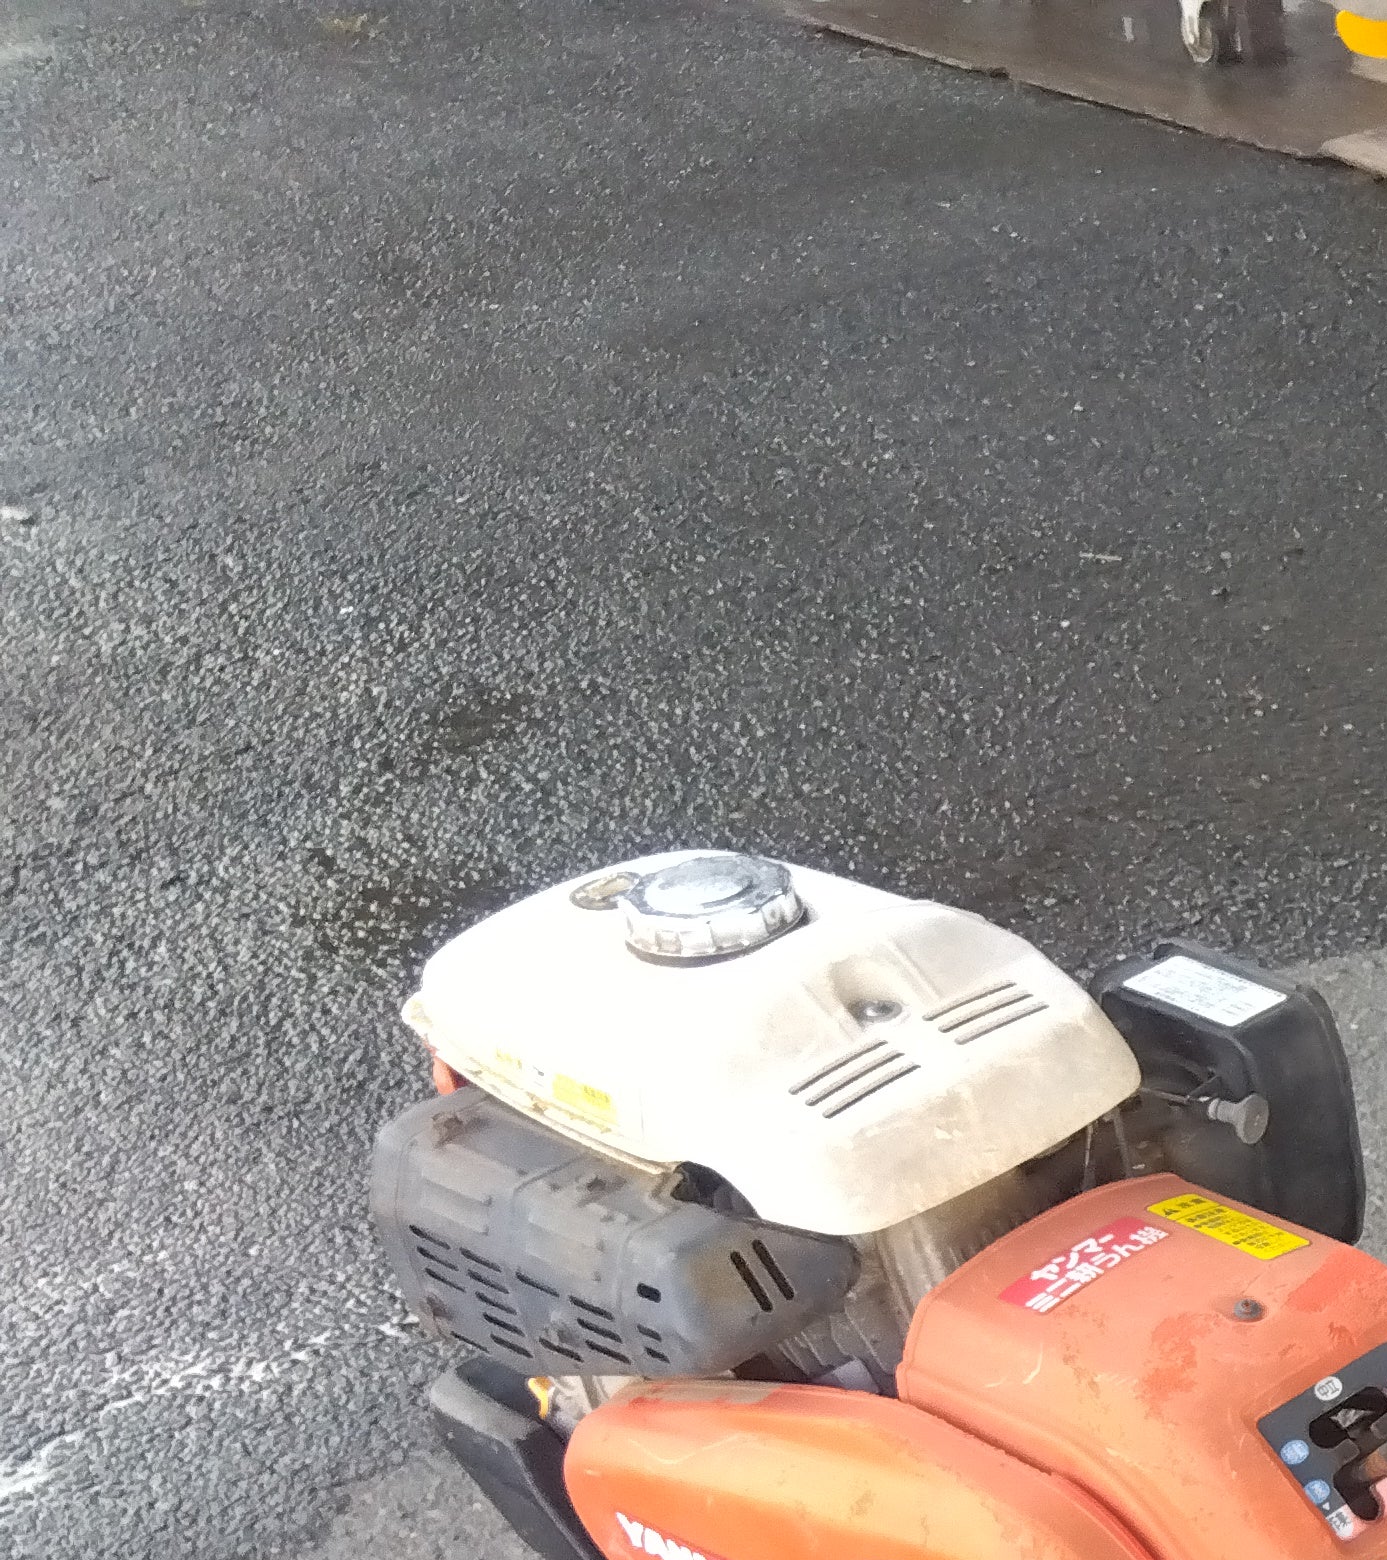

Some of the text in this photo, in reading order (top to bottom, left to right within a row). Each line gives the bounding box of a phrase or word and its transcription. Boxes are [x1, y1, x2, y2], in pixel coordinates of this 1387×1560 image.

[1025, 1226, 1169, 1313] ミニ耕うん機
[1030, 1233, 1114, 1281] ヤンマー
